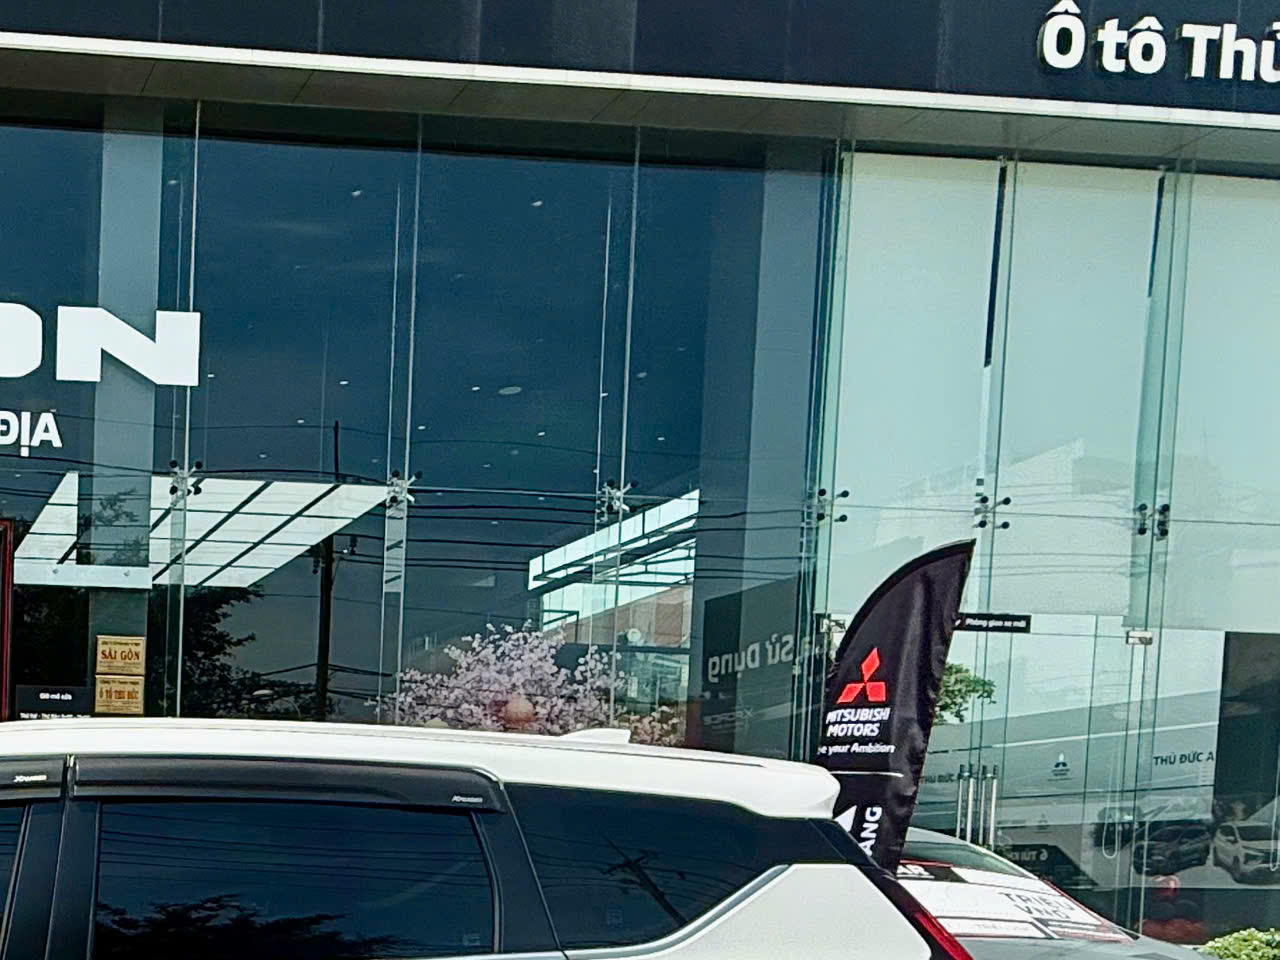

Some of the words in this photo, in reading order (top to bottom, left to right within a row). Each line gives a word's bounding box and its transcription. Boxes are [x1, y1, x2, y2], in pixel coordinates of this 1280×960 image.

[1042, 0, 1086, 69] Ô
[1096, 16, 1167, 74] tô
[825, 707, 891, 724] MITSUBISHI
[826, 723, 880, 737] MOTORS
